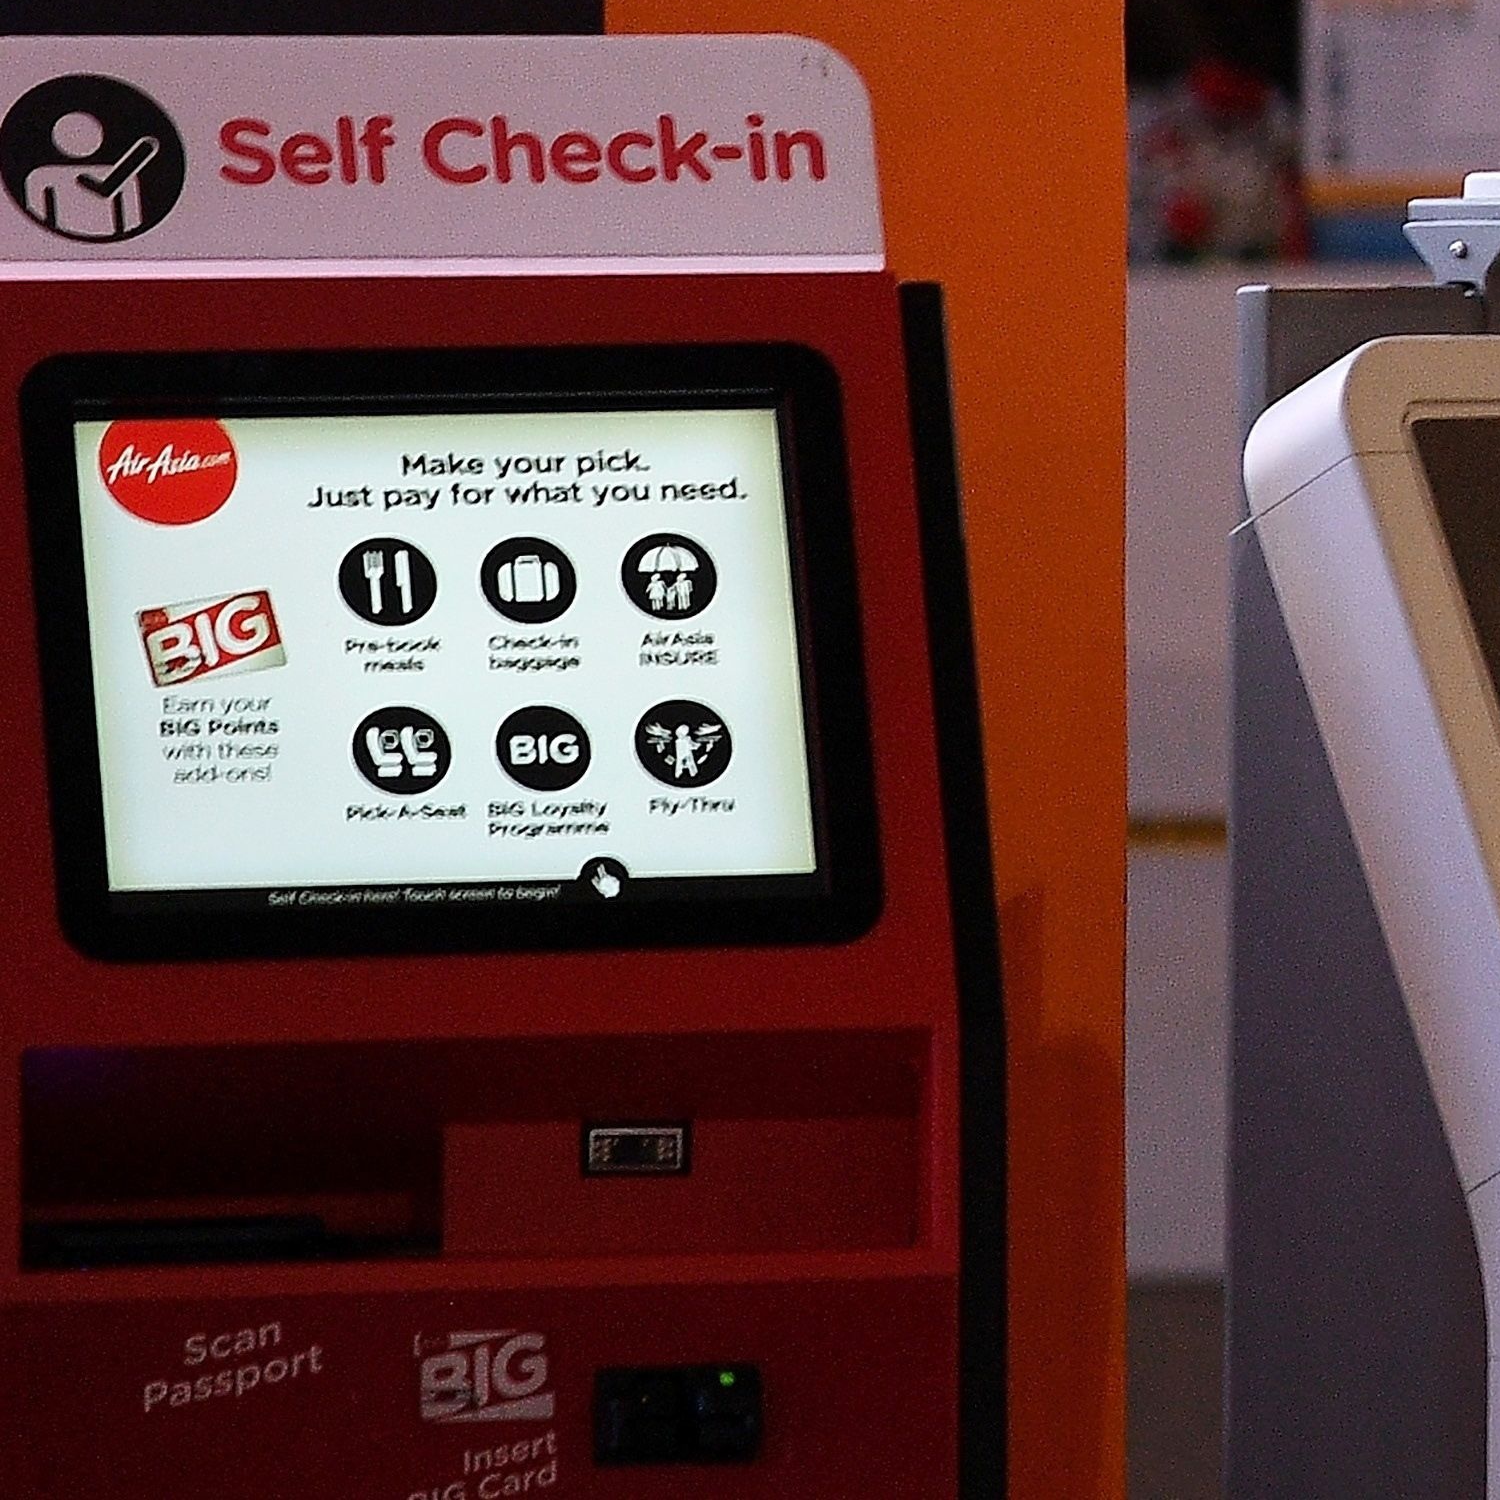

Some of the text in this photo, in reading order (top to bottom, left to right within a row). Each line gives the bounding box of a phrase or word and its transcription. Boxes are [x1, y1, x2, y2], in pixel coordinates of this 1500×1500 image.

[218, 112, 828, 186] Self Check-in
[402, 449, 650, 479] Make your pick.
[308, 476, 748, 512] Just pay for what you need.
[146, 595, 272, 686] BIG
[488, 653, 580, 673] baggage
[163, 697, 272, 715] Earn your
[160, 718, 280, 737] BIG Points
[163, 740, 279, 760] with these
[509, 734, 579, 765] BIG
[488, 802, 523, 818] BIG
[183, 1321, 283, 1367] Scan
[143, 1345, 324, 1413] Passport
[420, 1331, 549, 1420] BIG
[463, 1428, 557, 1477] Insert
[477, 1459, 557, 1500] Card
